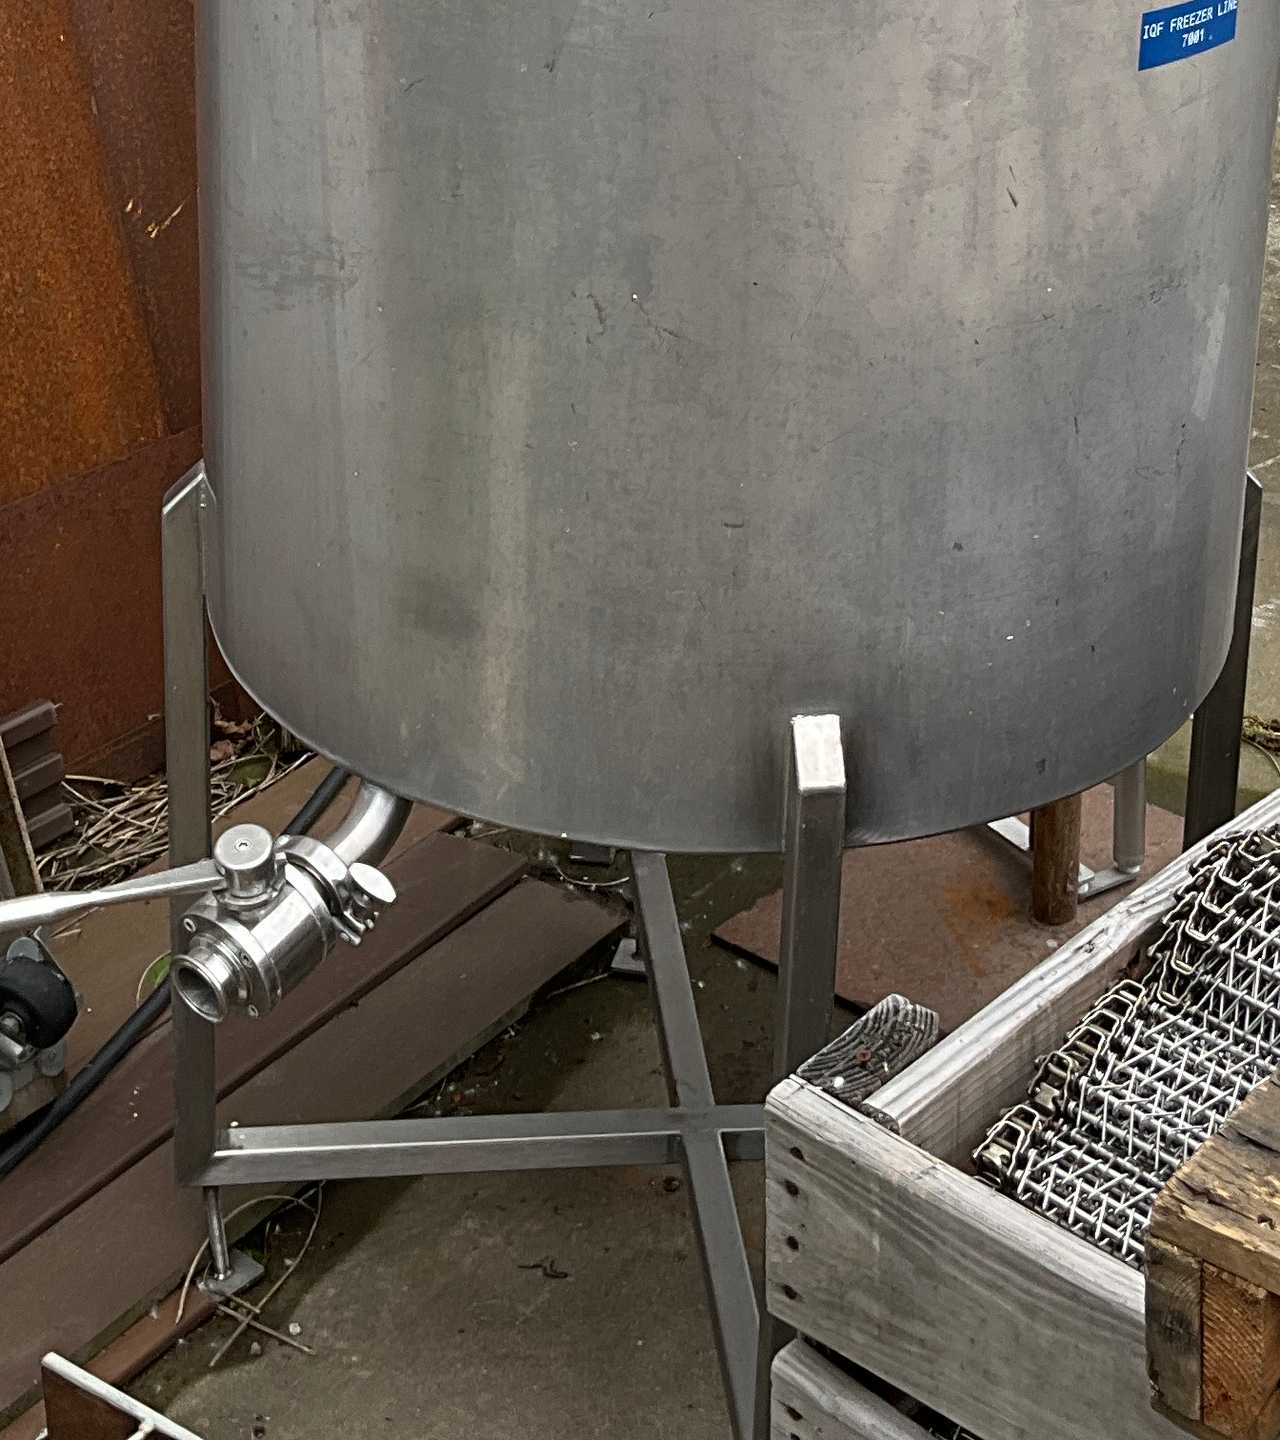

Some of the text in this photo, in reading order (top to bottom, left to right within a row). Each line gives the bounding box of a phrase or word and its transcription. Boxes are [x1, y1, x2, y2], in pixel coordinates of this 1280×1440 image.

[1143, 21, 1164, 40] IQF
[1169, 6, 1213, 32] FREEZER
[1182, 28, 1205, 48] 7001
